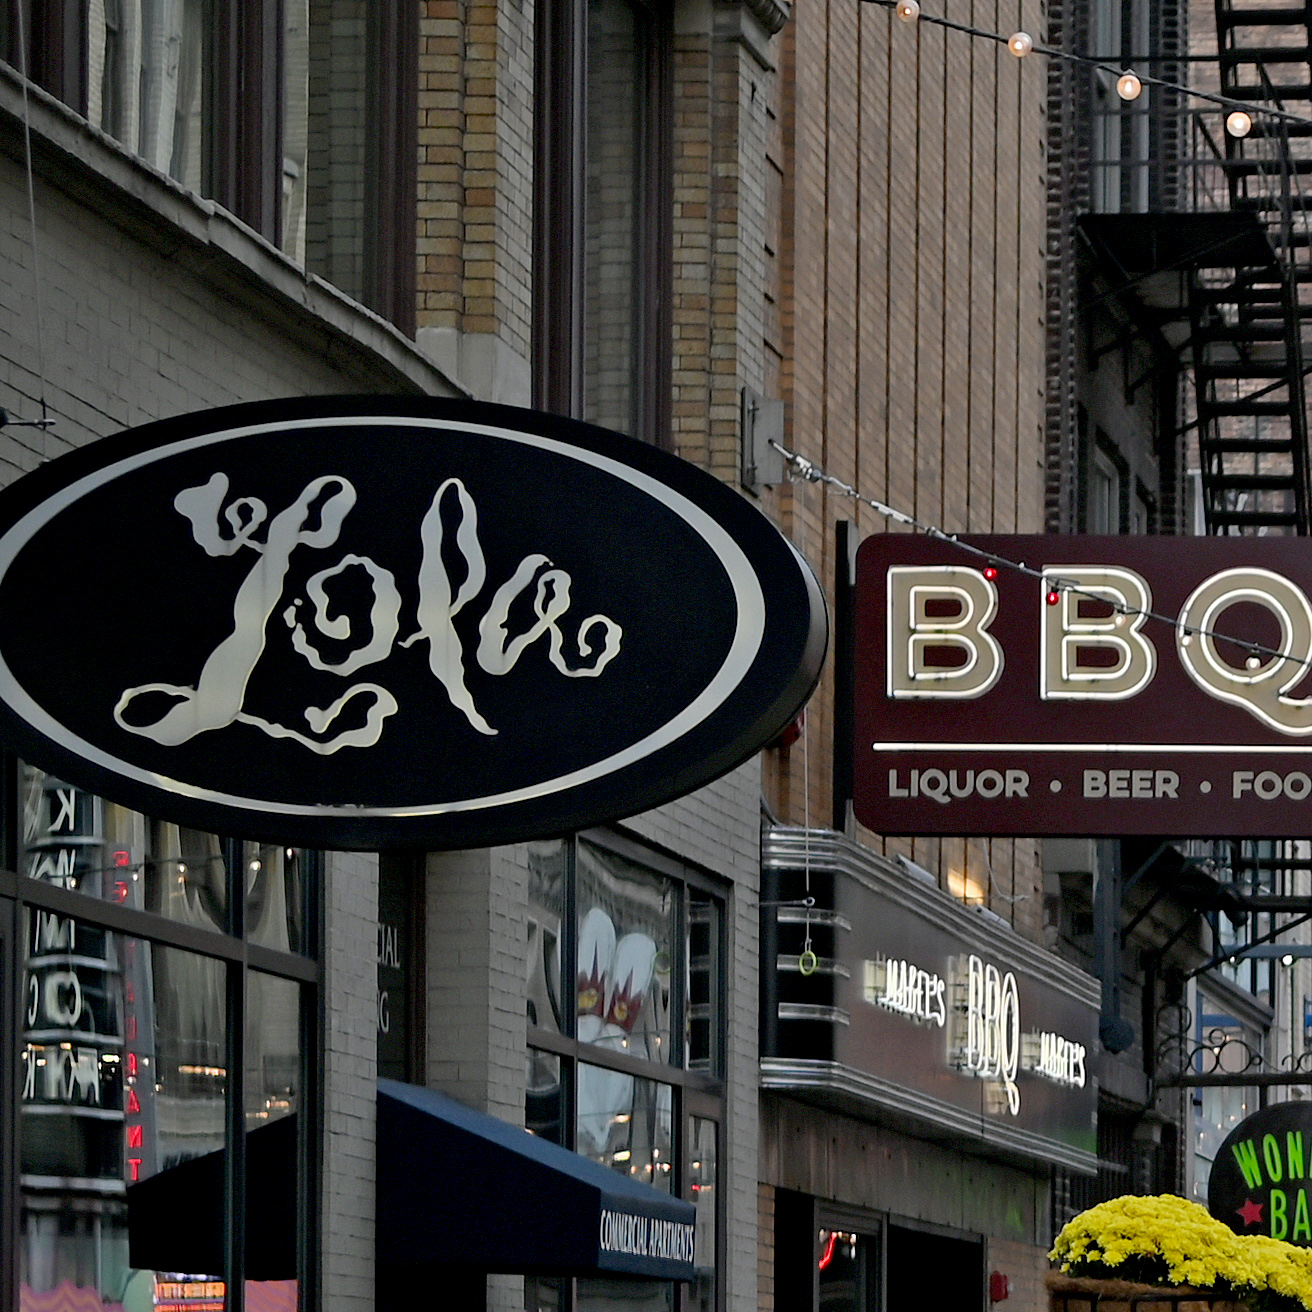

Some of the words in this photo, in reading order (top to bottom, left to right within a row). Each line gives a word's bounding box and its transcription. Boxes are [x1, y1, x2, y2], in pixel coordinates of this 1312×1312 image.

[113, 471, 622, 755] Lola
[888, 769, 1030, 804] LIQUOR
[1083, 769, 1180, 799] BEER
[968, 954, 1020, 1116] BBQ
[599, 1209, 648, 1255] COMMERCIAL
[648, 1218, 694, 1263] APARTMENTS
